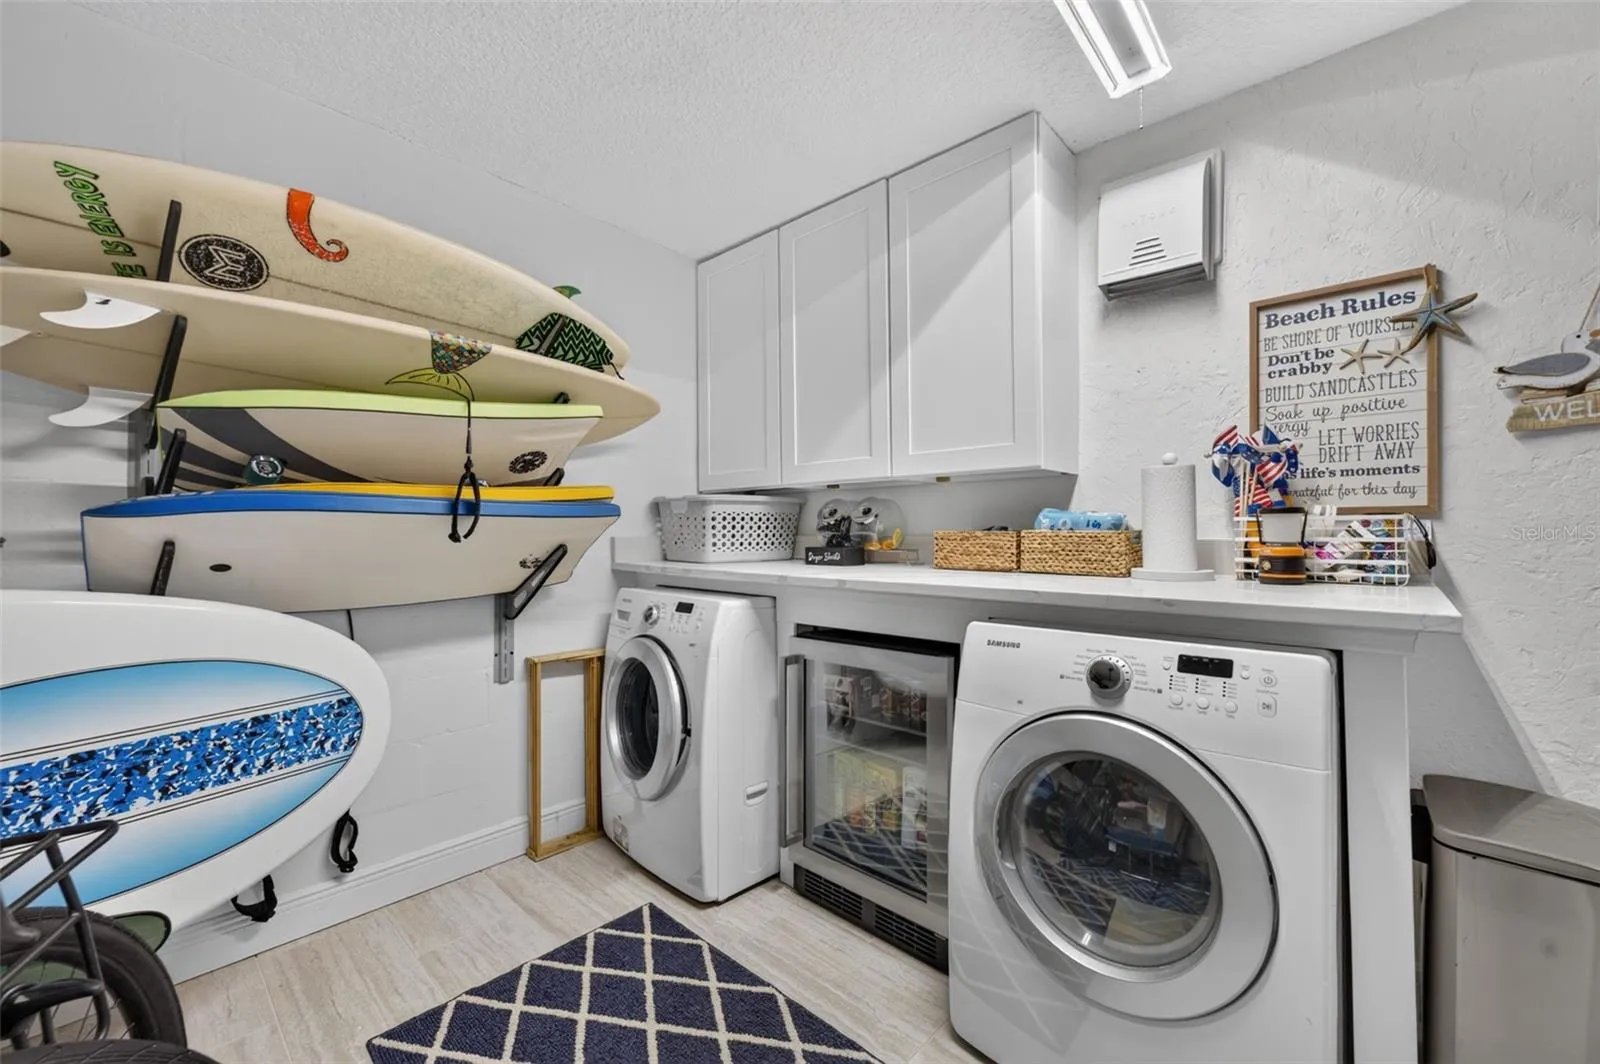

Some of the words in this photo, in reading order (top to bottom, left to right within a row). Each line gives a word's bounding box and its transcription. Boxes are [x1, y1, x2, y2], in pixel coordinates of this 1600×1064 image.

[53, 160, 125, 238] ENERGY
[101, 239, 137, 257] IS
[111, 261, 147, 278] E
[1265, 303, 1335, 330] Beach
[1341, 290, 1416, 316] Rules
[1264, 336, 1279, 352] BE
[1282, 328, 1322, 350] SHORE
[1326, 325, 1343, 341] OF
[1268, 349, 1312, 367] Don't
[1314, 348, 1335, 361] be
[1267, 361, 1333, 379] crabby
[1265, 383, 1305, 403] BUILD
[1309, 368, 1418, 399] SANDCASTLES
[1265, 404, 1304, 422] Soak
[1312, 407, 1334, 423] up
[1341, 396, 1408, 421] positive
[1273, 420, 1311, 438] ergy
[1318, 427, 1347, 446] LET
[1353, 420, 1420, 443] WORRIES
[1318, 444, 1364, 464] DRIFT
[1374, 440, 1416, 460] AWAY
[1300, 466, 1337, 479] life's
[1339, 463, 1421, 478] moments
[1337, 483, 1358, 500] for
[1362, 482, 1388, 495] this
[1392, 480, 1418, 499] day
[987, 640, 1020, 649] SAMSUNG
